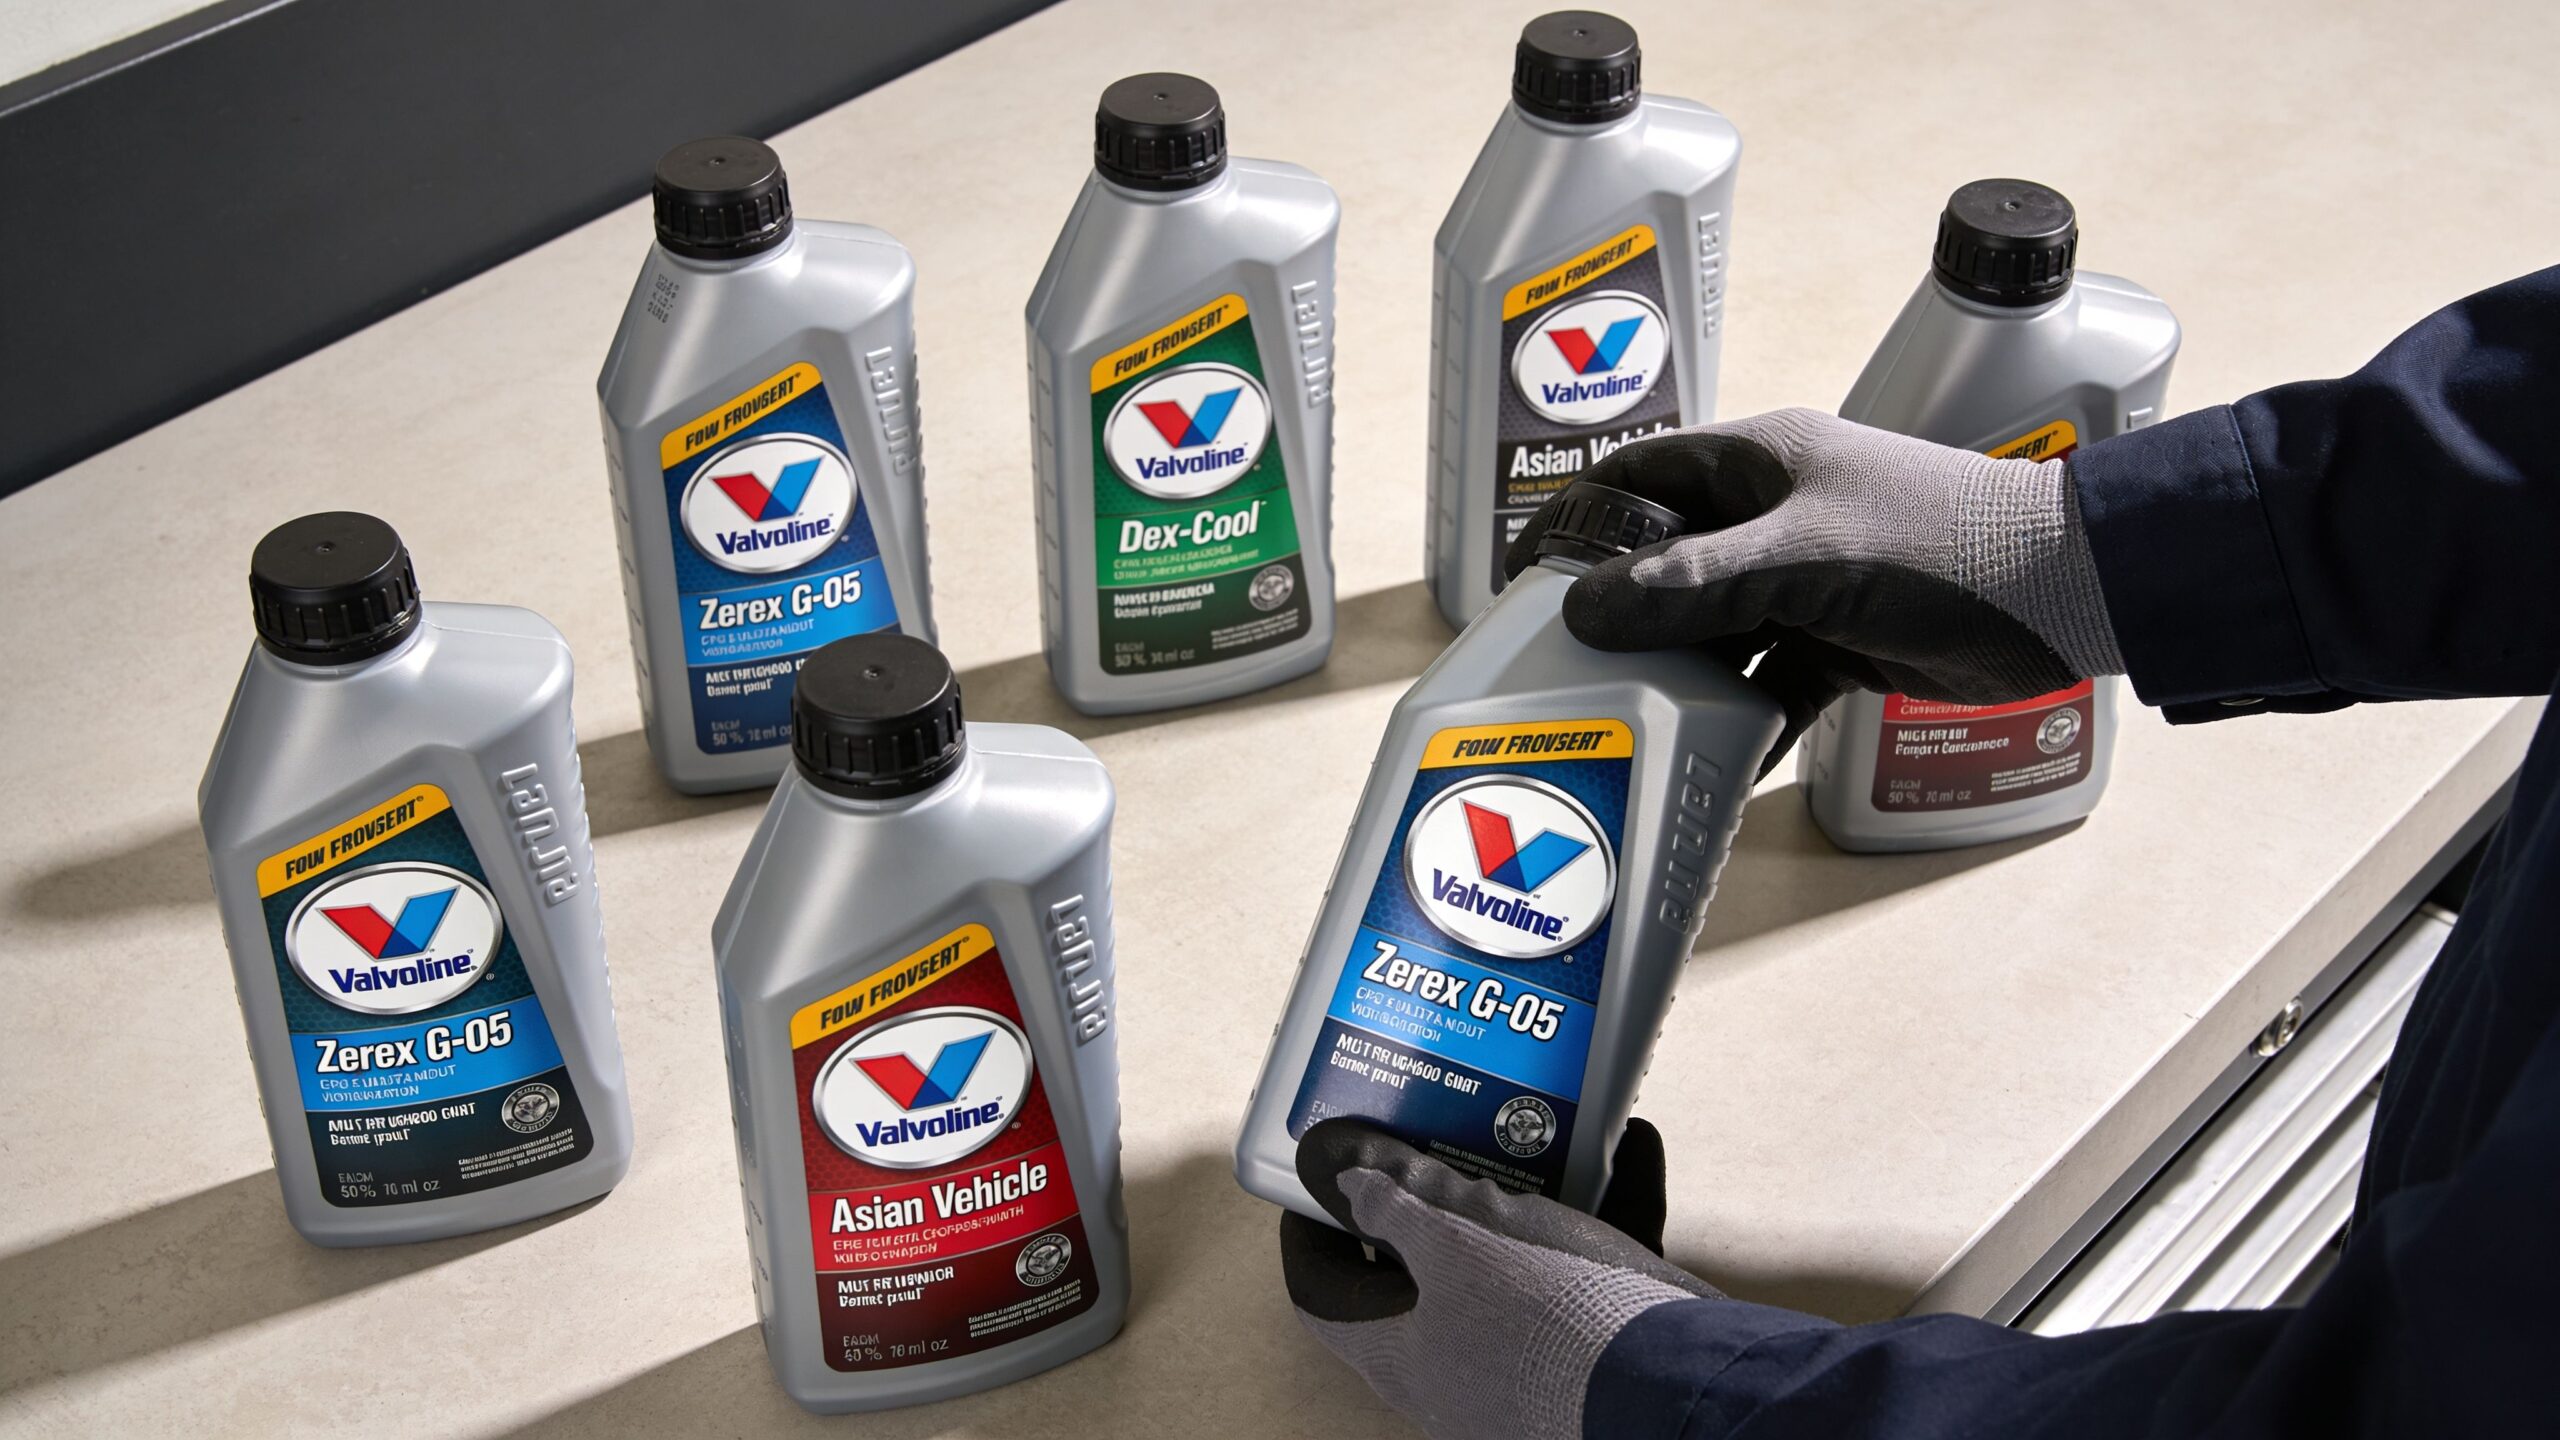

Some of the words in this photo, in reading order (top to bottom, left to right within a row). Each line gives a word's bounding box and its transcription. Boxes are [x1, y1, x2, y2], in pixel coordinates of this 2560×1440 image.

[1541, 374, 1644, 405] Valvoline
[1135, 448, 1245, 480] Valvoline
[1509, 444, 1584, 479] Asian
[716, 516, 831, 555] Valvoline
[1118, 499, 1261, 554] Dex-Cool
[698, 595, 784, 630] Zerex
[791, 569, 863, 617] G-05
[1452, 736, 1506, 759] FOW
[1432, 867, 1564, 941] Valvoline
[327, 953, 472, 994] Valvoline
[1361, 938, 1471, 1012] Zerex
[1469, 976, 1567, 1042] G-05
[820, 993, 865, 1030] FOW
[314, 1039, 419, 1074] Zerex
[425, 1009, 514, 1063] G-05
[855, 1100, 1002, 1147] Valvoline
[401, 1179, 418, 1194] ml
[423, 1178, 441, 1192] oz
[829, 1195, 925, 1235] Asian
[930, 1160, 1049, 1219] Vehicle
[908, 1340, 926, 1355] ml
[930, 1338, 950, 1352] oz
